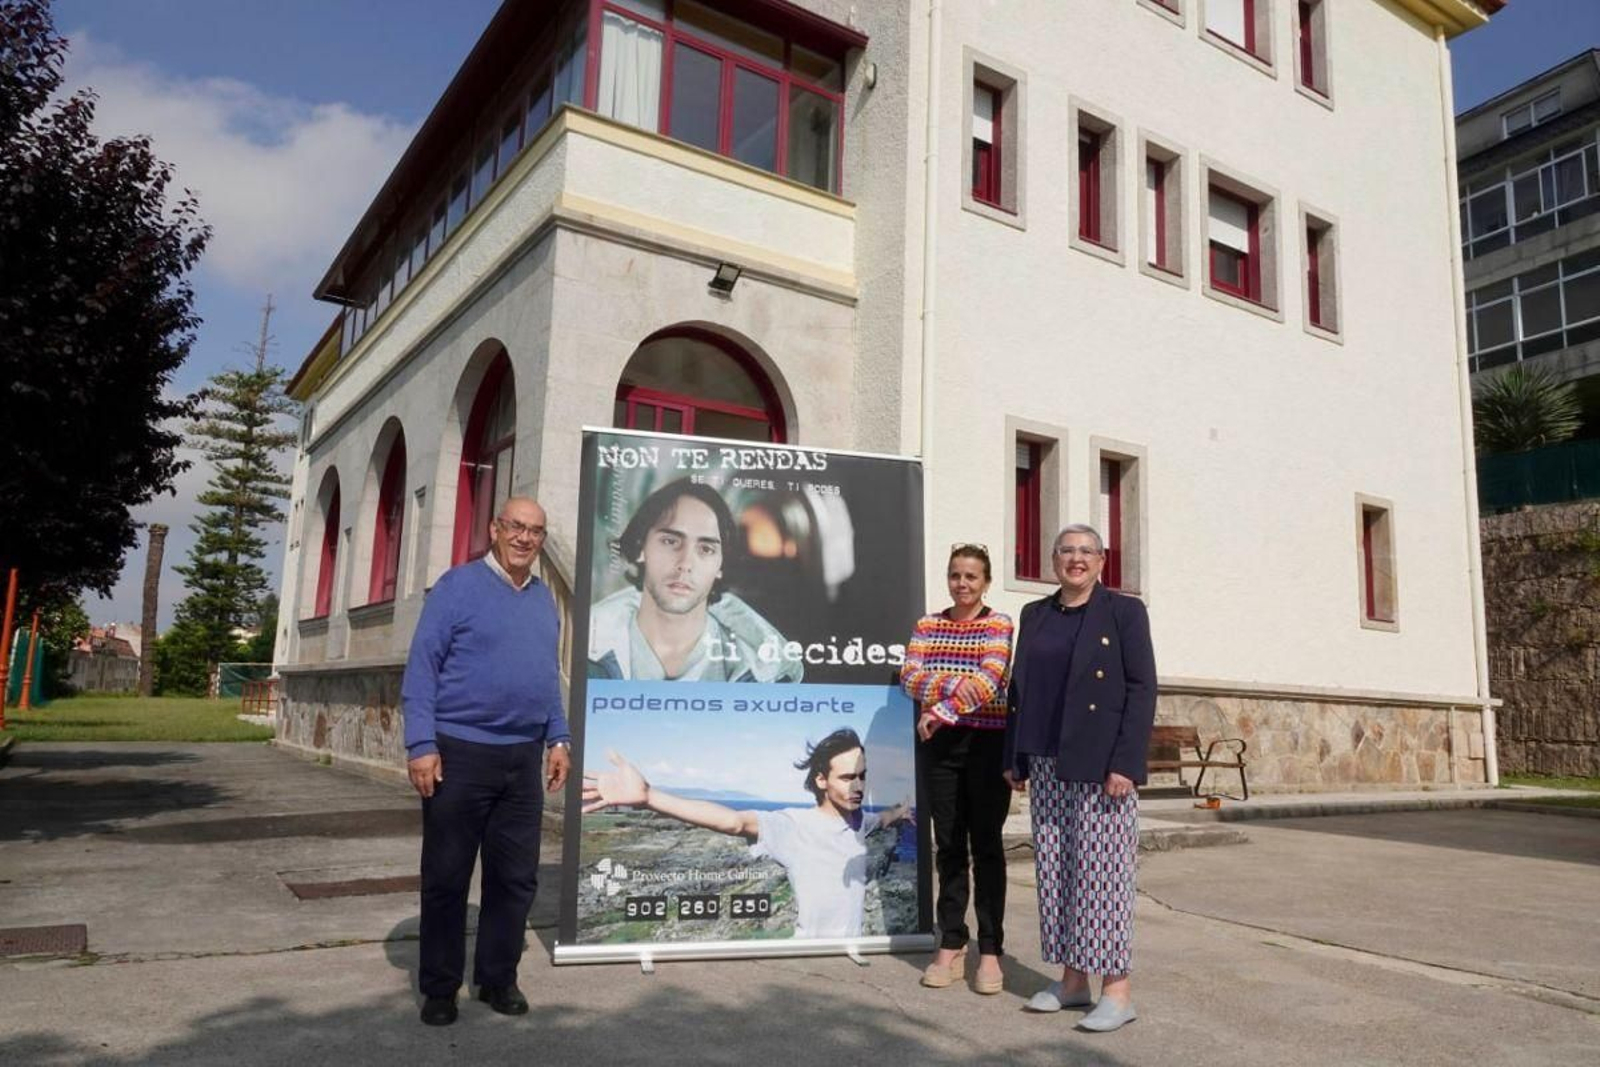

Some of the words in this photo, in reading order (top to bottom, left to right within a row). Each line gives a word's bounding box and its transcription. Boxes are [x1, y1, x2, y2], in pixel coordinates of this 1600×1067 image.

[598, 446, 659, 469] NON
[672, 448, 709, 470] TE
[720, 448, 828, 471] RENDAS
[691, 474, 705, 484] SE
[787, 482, 799, 491] TI
[705, 633, 741, 662] ti
[757, 635, 906, 666] decides
[592, 694, 723, 713] podemos
[733, 696, 855, 713] axudarte
[632, 869, 685, 884] Proxecto
[689, 868, 725, 882] Home
[627, 902, 666, 916] 902
[680, 900, 717, 915] 260
[732, 899, 768, 913] 250
